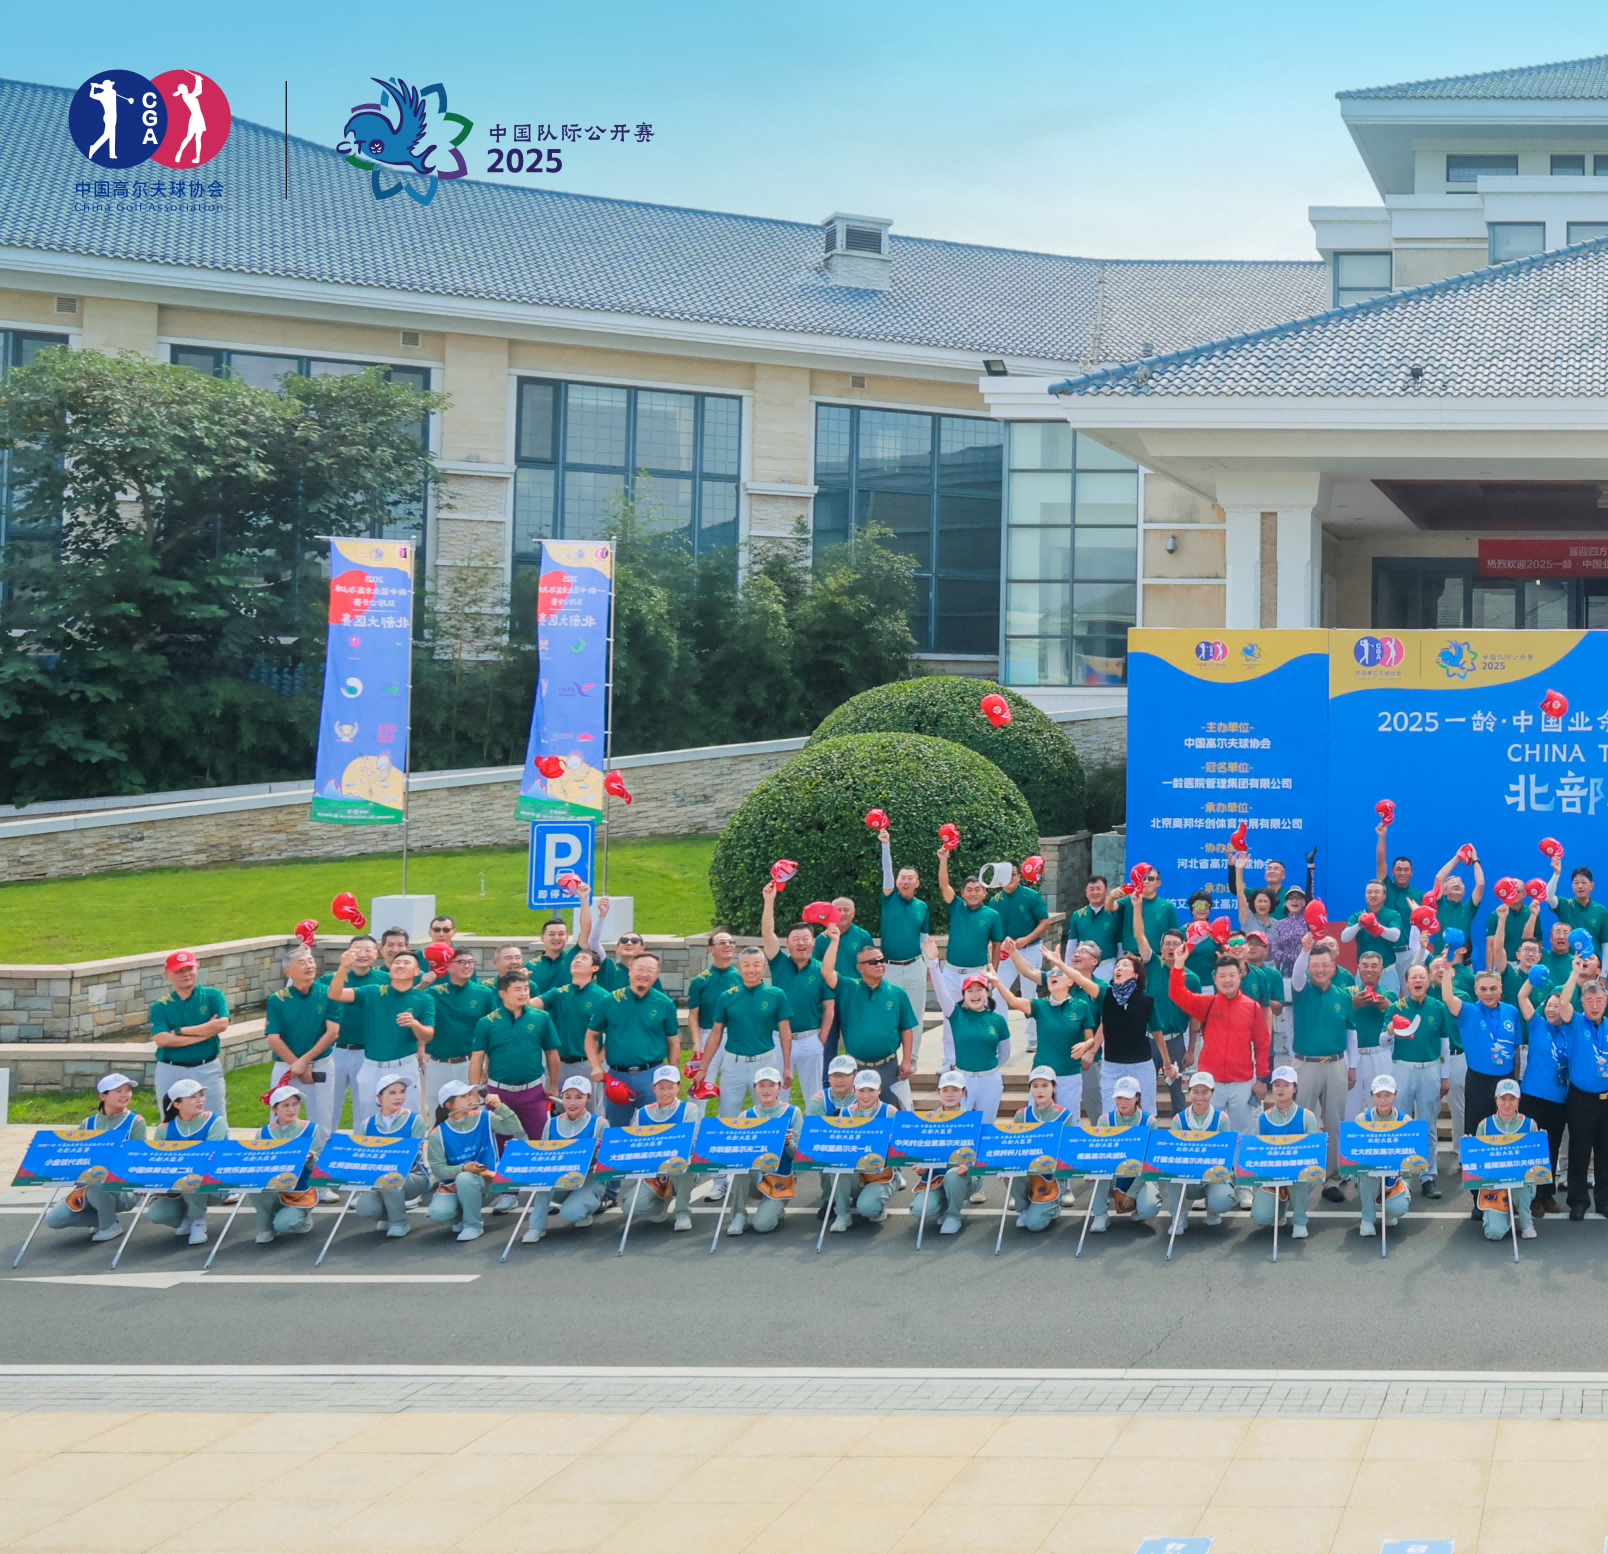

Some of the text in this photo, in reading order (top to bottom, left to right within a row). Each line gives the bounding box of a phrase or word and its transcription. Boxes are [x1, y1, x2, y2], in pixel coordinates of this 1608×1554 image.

[1482, 662, 1506, 670] 2025
[1184, 738, 1271, 749] 中国高尔夫球协会
[1507, 744, 1586, 763] CHINA
[1162, 778, 1292, 790] 一龄医院管理集团有限公司
[544, 833, 582, 886] P
[1177, 858, 1273, 869] 河北省高尔球协会
